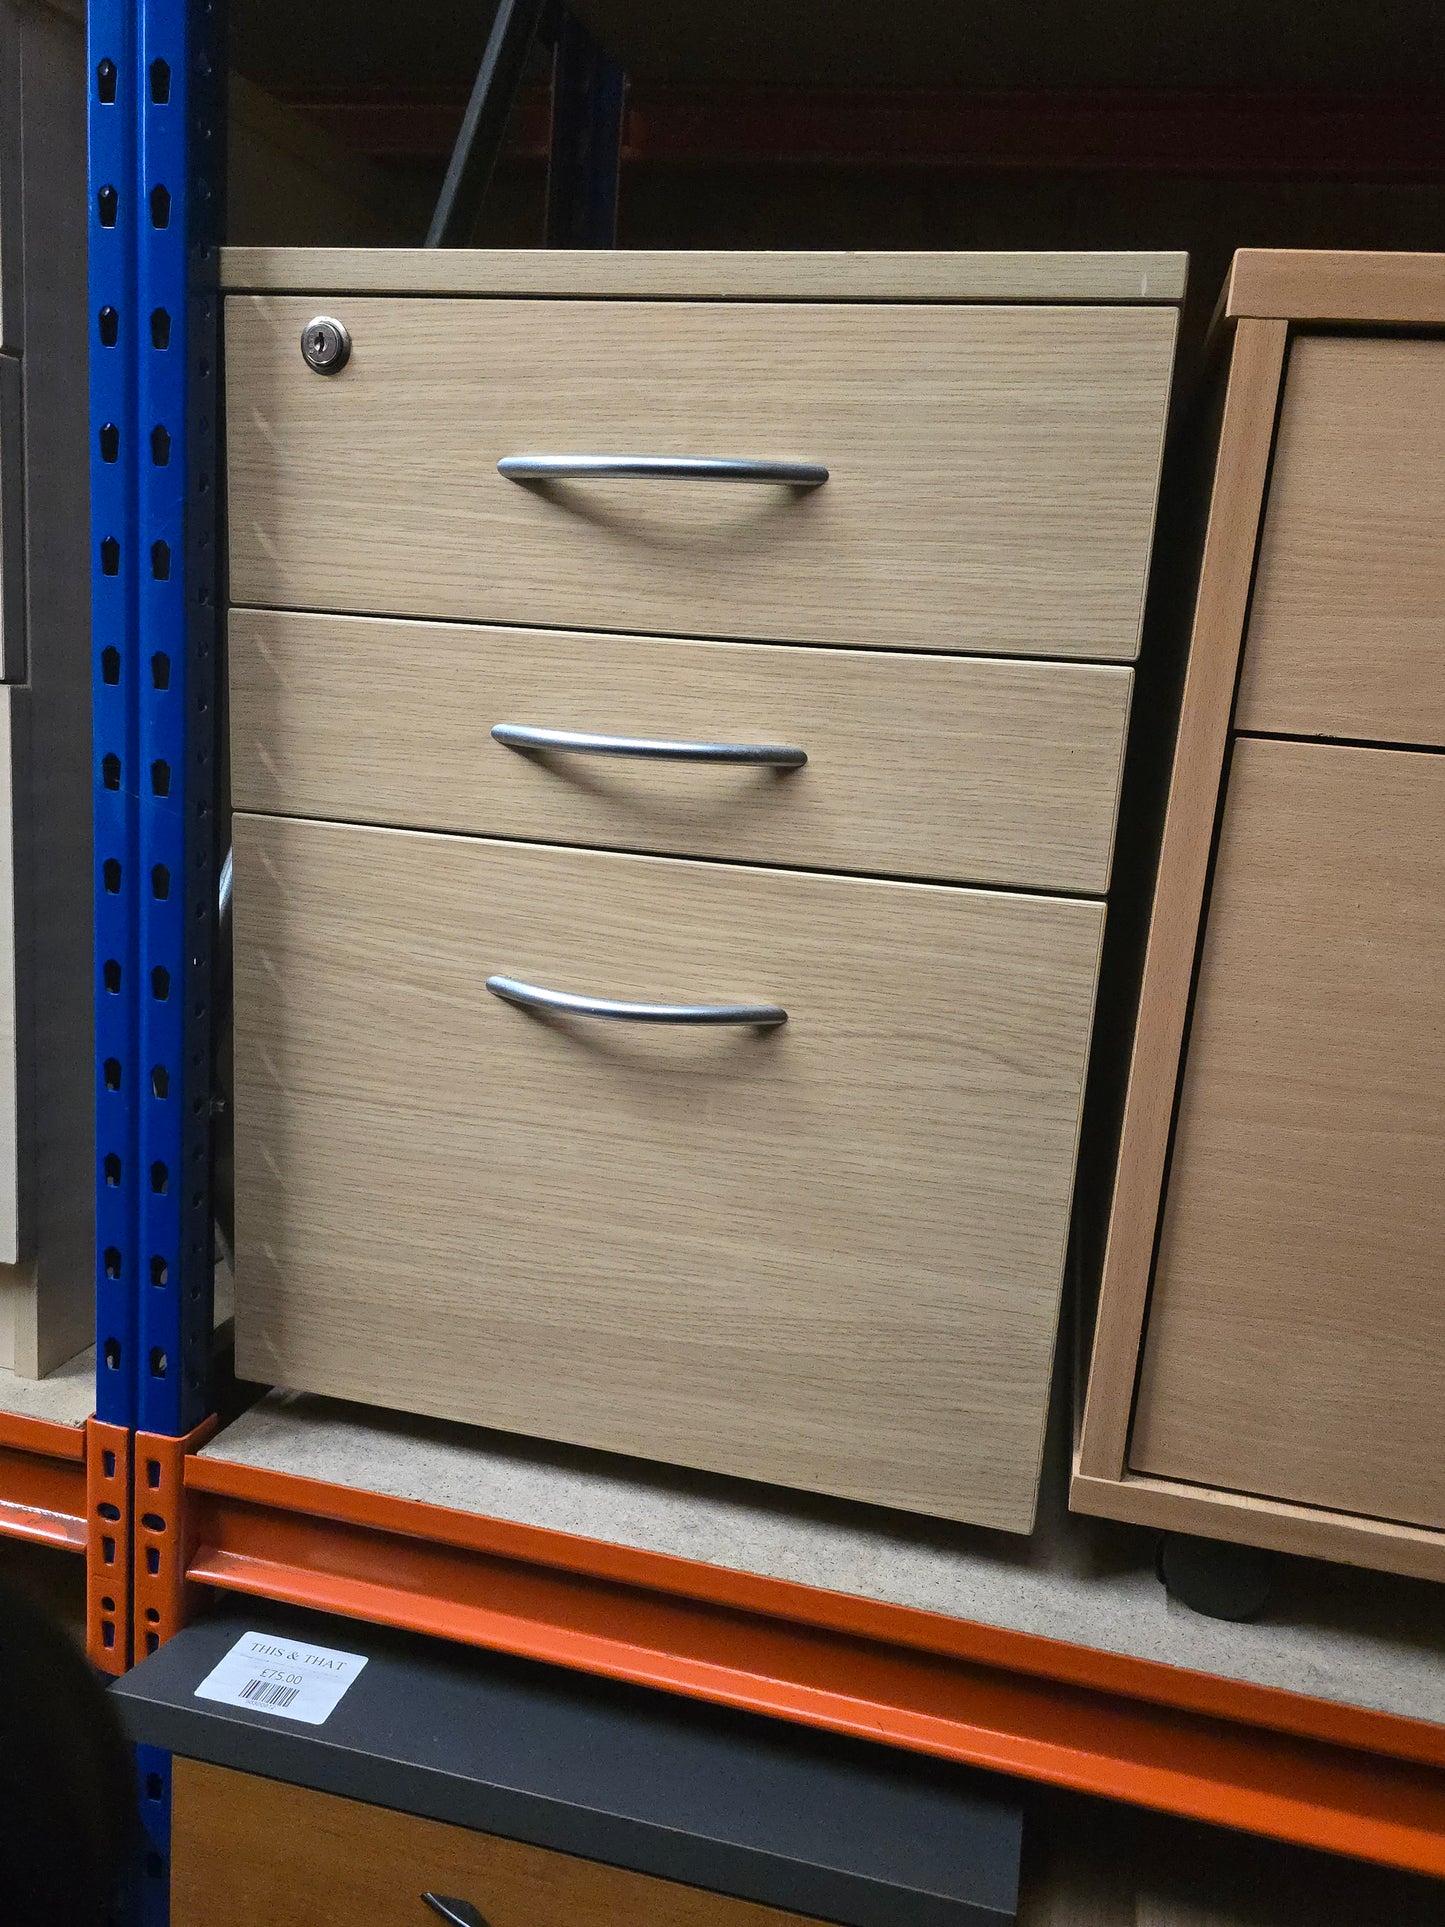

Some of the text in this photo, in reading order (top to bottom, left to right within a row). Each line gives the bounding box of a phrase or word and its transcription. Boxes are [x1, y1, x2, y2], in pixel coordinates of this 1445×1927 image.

[251, 1642, 347, 1670] THIS & THAT
[260, 1668, 303, 1685] £75.00
